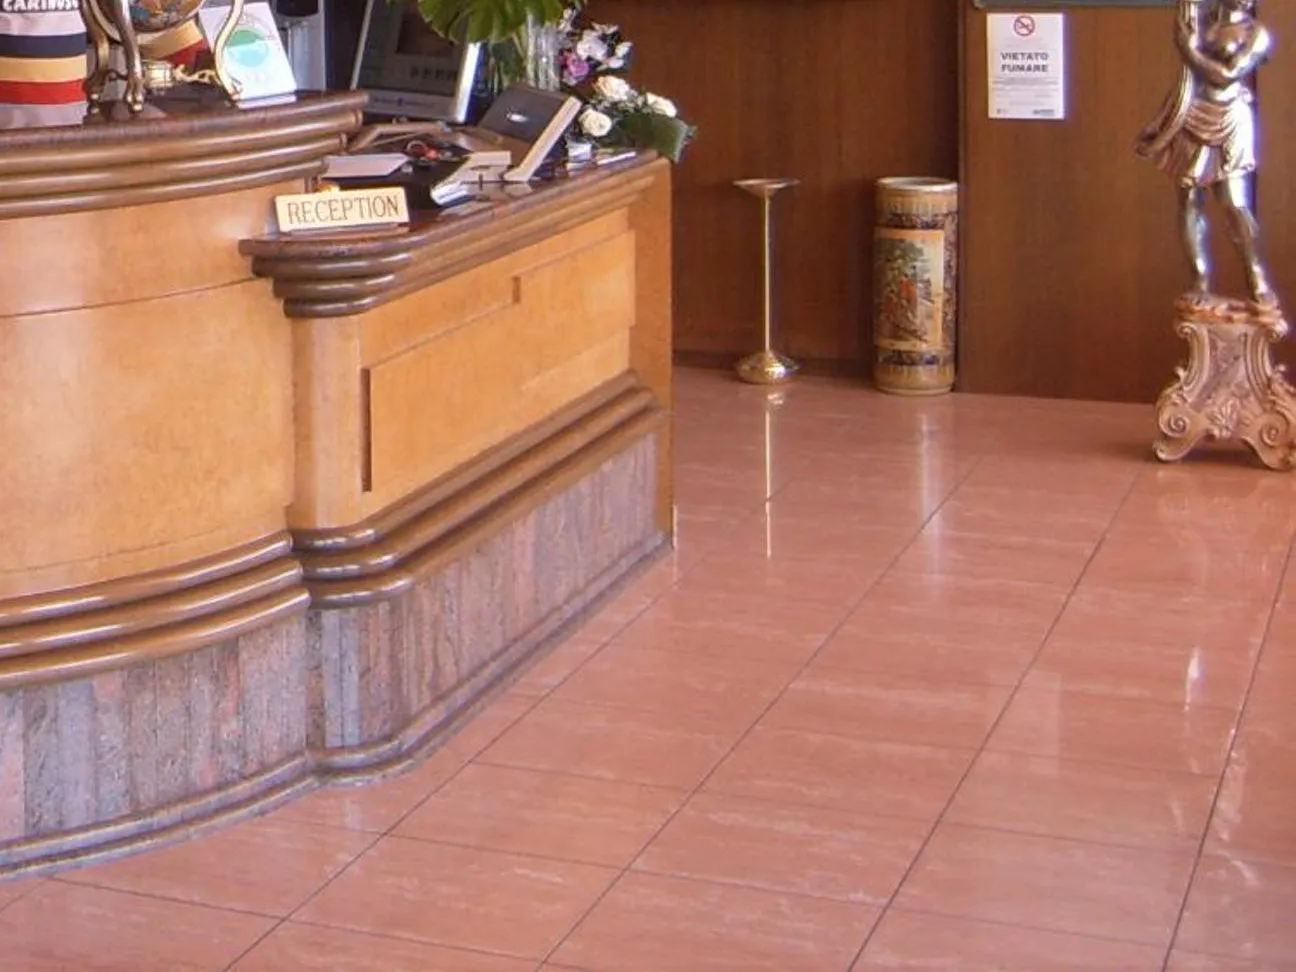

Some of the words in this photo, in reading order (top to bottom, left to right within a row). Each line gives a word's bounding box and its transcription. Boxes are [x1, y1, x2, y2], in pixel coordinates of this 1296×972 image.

[1000, 51, 1049, 61] VIETATO
[1001, 63, 1048, 73] FUMARE
[286, 194, 400, 225] RECEPTION
